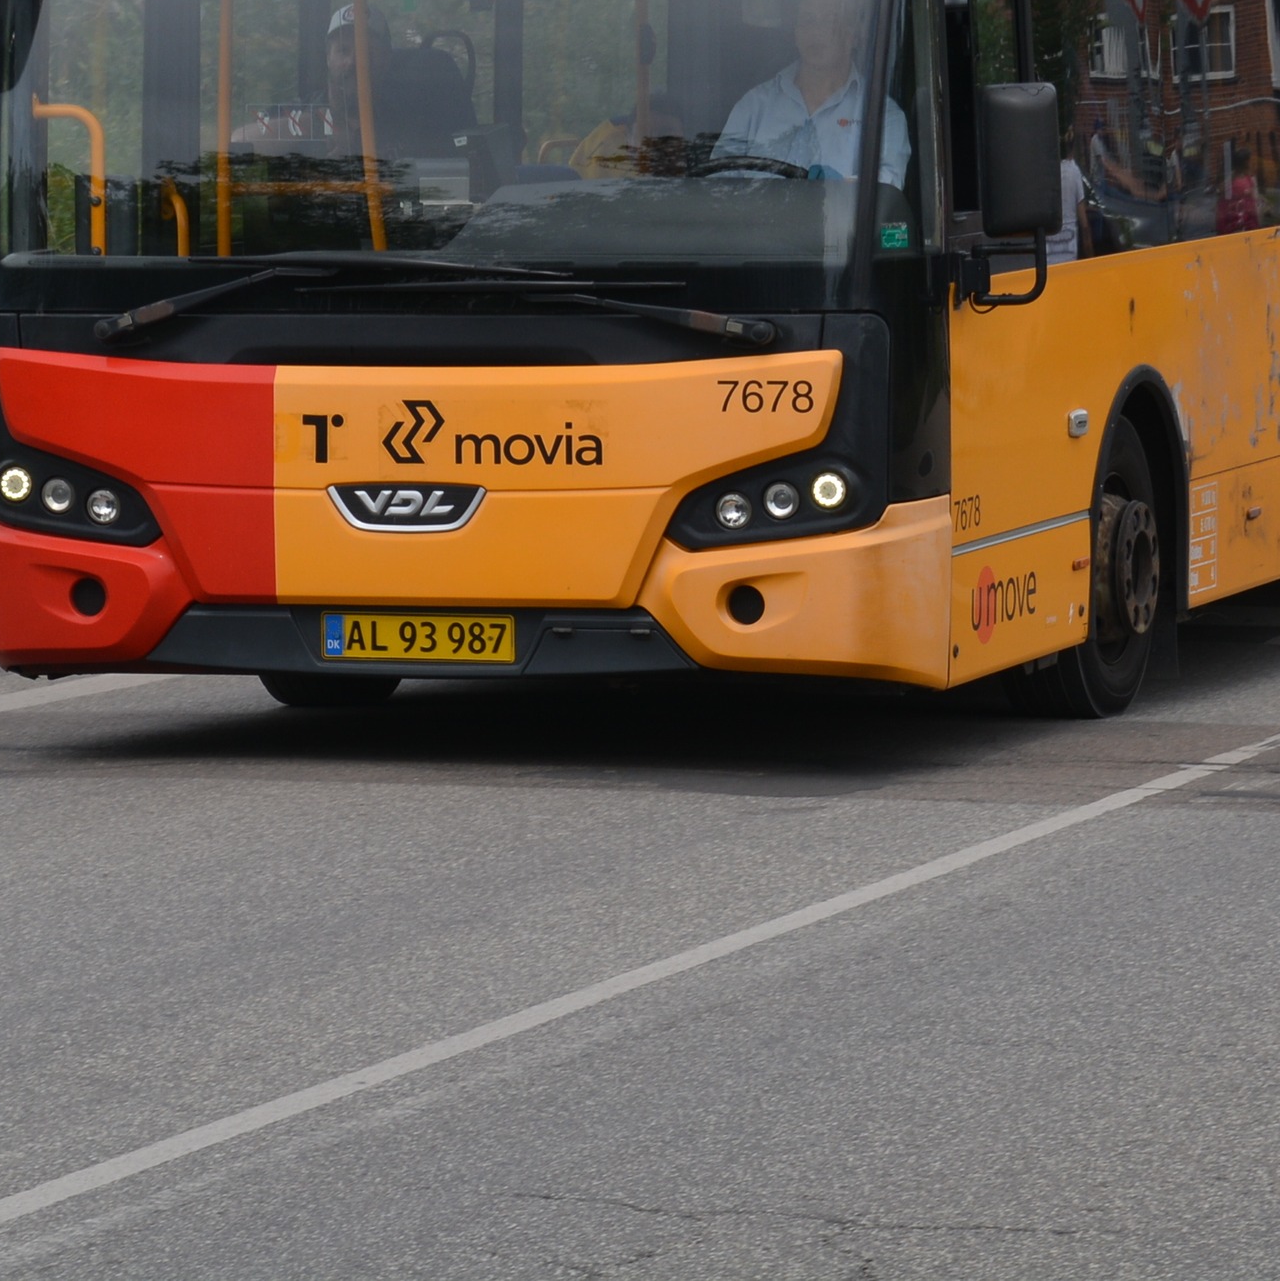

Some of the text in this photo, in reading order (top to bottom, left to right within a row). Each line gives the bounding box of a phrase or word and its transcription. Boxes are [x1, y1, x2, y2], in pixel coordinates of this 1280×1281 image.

[717, 379, 814, 413] 7678
[454, 421, 603, 466] movia
[354, 489, 455, 517] VDL
[953, 494, 981, 533] 7678
[327, 639, 340, 650] DK
[346, 620, 507, 655] AL 93 987
